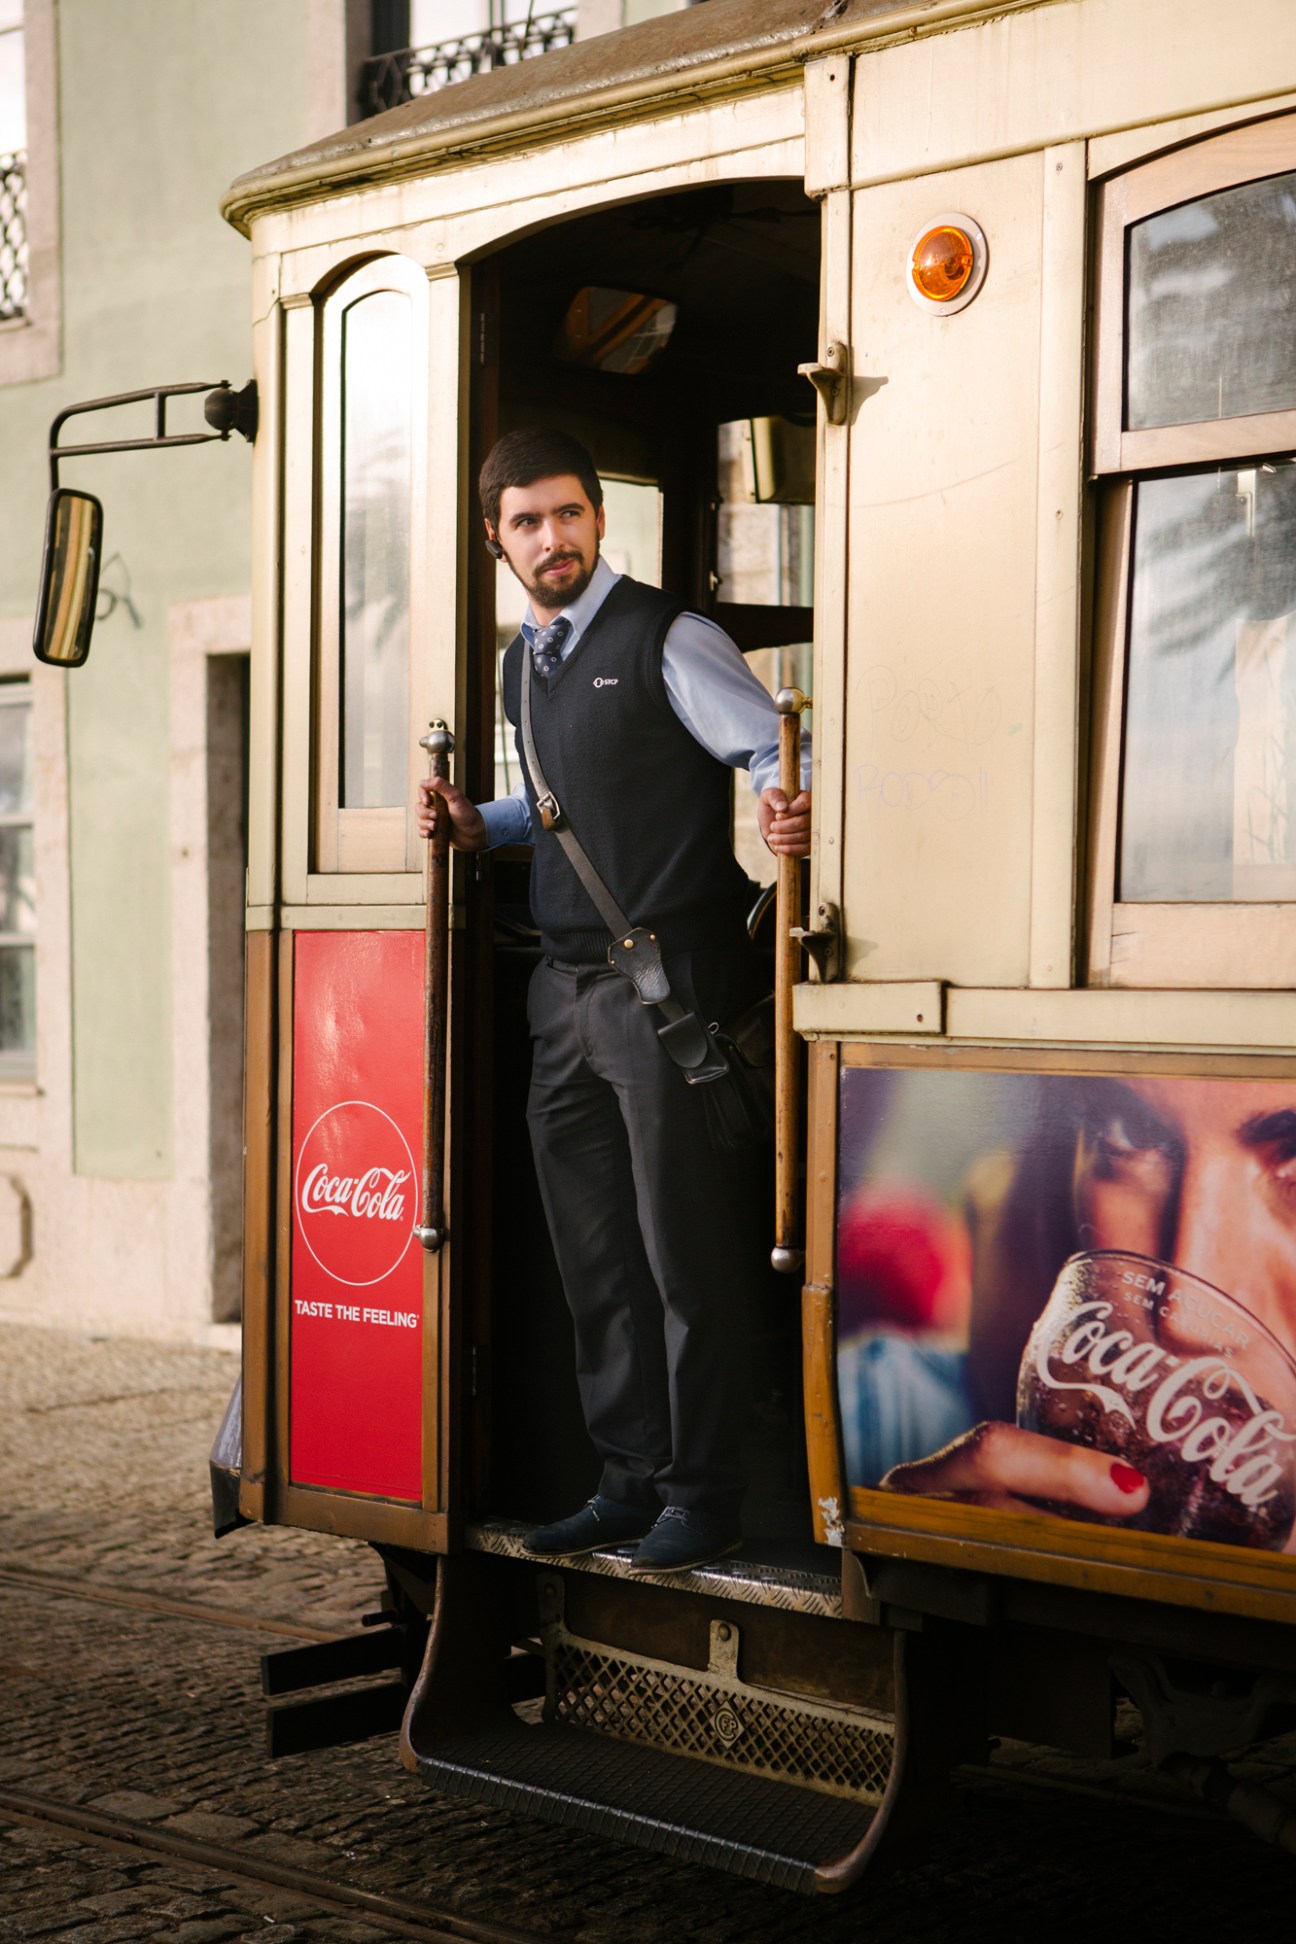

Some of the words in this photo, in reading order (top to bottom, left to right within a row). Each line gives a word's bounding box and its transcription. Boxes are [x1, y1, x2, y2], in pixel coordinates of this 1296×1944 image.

[301, 1163, 412, 1221] Coca-Cola
[1122, 1271, 1166, 1296] SEM
[294, 1300, 333, 1318] TASTE
[335, 1304, 361, 1321] THE
[363, 1308, 417, 1329] FEELING
[1123, 1291, 1155, 1311] SEM
[1036, 1300, 1296, 1505] Coca-Cola
